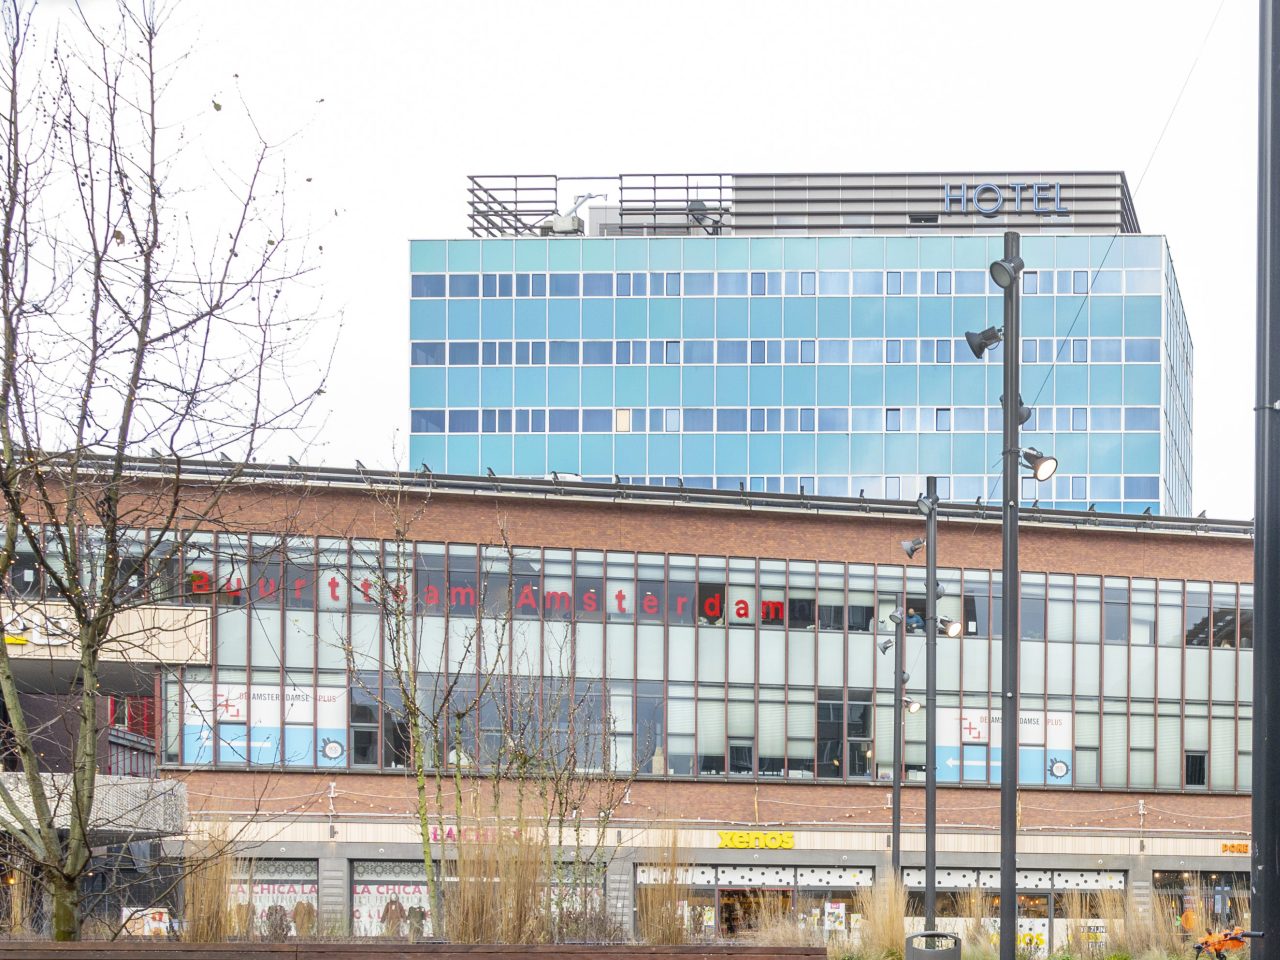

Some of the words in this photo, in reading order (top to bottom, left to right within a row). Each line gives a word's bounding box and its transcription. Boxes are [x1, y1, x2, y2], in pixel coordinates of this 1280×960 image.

[944, 183, 1069, 213] HOTEL
[191, 560, 478, 606] Buurtteam
[515, 583, 785, 621] Amsterdam
[318, 695, 337, 703] PLUS
[1047, 719, 1063, 727] PLUS
[718, 831, 796, 850] xenos
[353, 884, 372, 896] LA
[376, 884, 422, 896] CHICA
